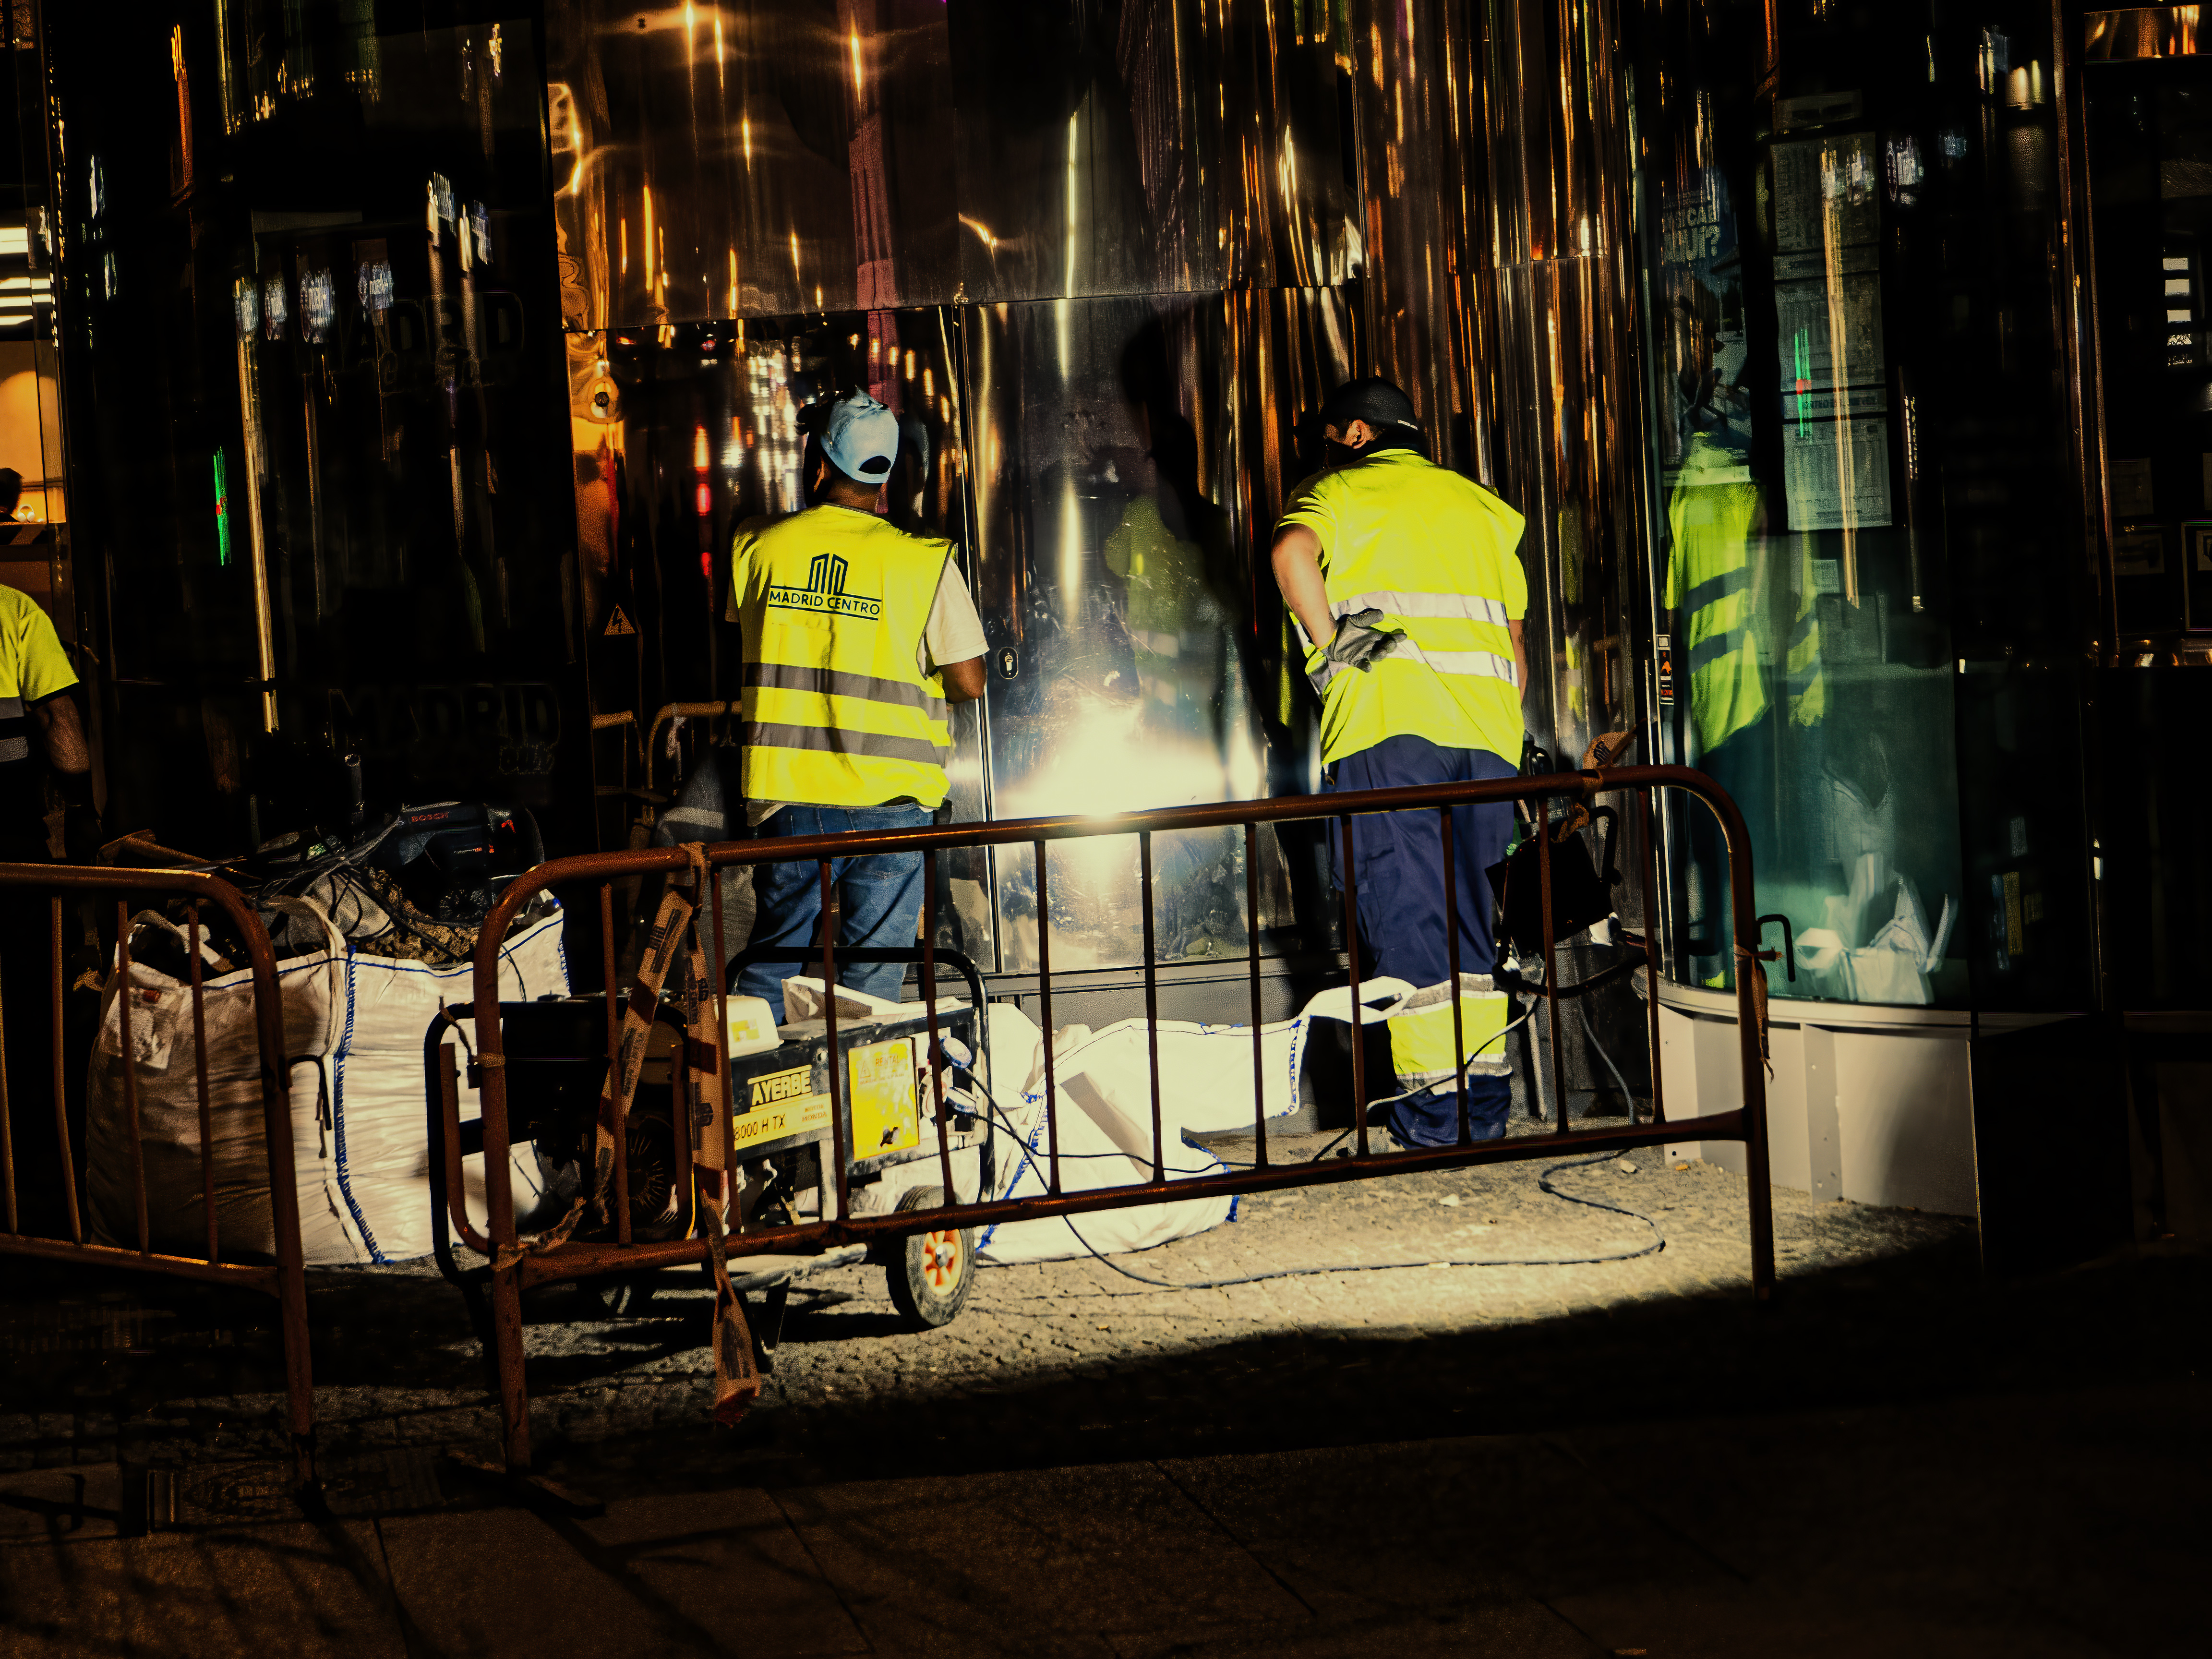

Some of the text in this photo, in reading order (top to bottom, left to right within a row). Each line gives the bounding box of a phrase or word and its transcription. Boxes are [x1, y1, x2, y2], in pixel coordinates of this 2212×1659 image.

[769, 590, 880, 615] MADRID CENTRO
[752, 1070, 812, 1106] AYERBE
[734, 1114, 785, 1141] 8000 H TX
